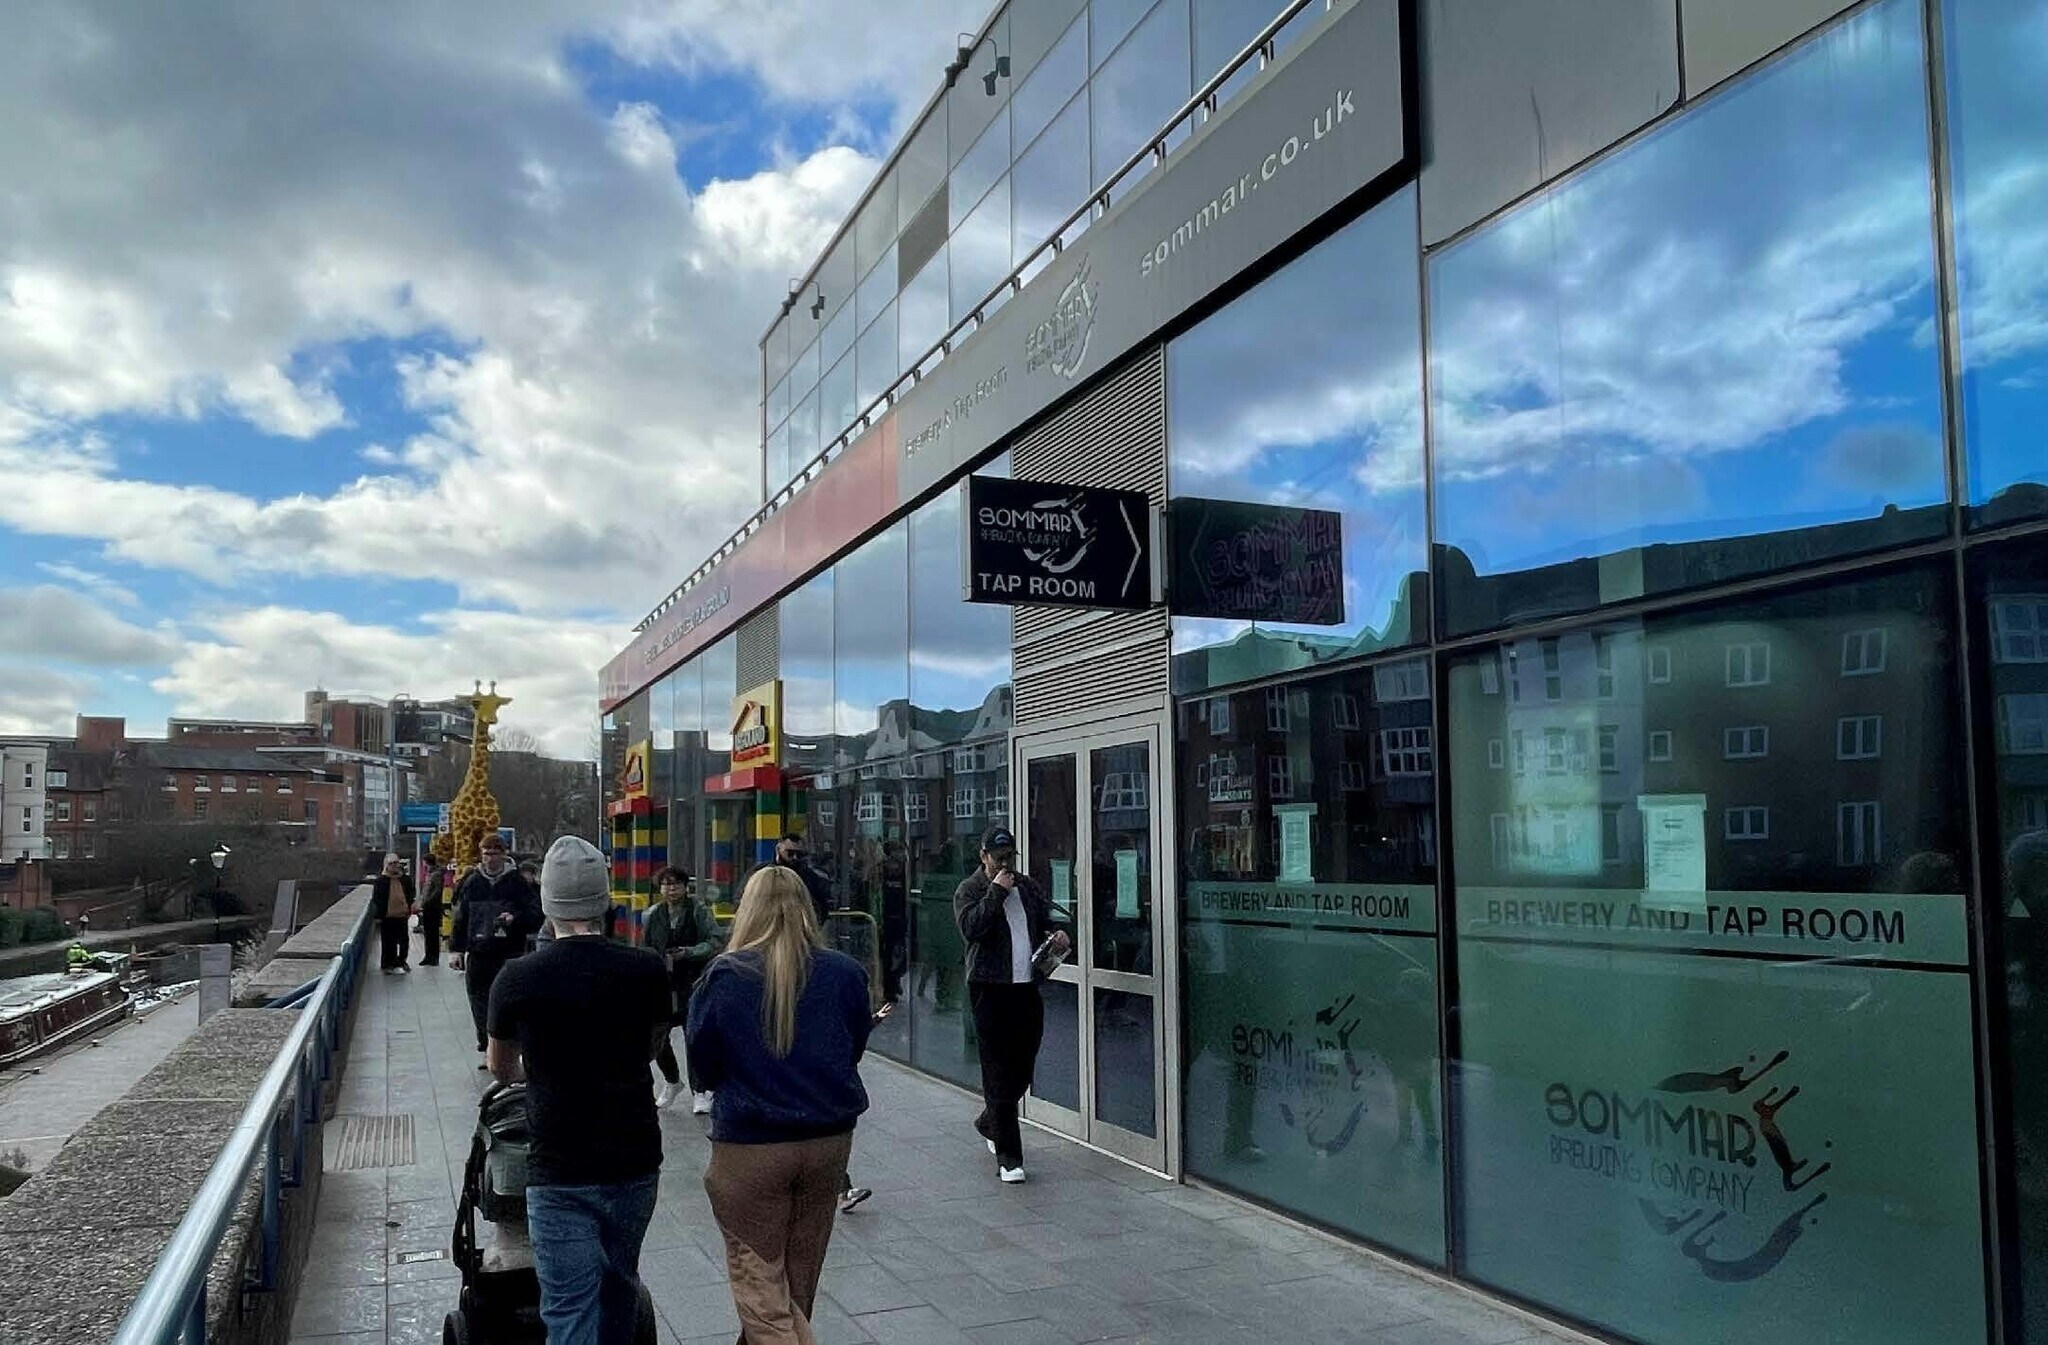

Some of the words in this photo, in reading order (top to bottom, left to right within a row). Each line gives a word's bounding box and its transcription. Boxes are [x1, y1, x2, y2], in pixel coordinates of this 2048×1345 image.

[1141, 90, 1355, 277] sommar.co.uk
[978, 507, 1071, 532] SOMMAR
[978, 573, 1022, 592] TAP
[1029, 577, 1096, 599] ROOM
[1202, 890, 1270, 911] BREWERY
[1311, 894, 1345, 914] TAP
[1351, 895, 1410, 919] ROOM
[1487, 899, 1615, 930] BREWERY
[1626, 902, 1690, 931] AND
[1705, 905, 1768, 936] TAP
[1783, 907, 1905, 945] ROOM
[1544, 1082, 1757, 1168] SOMMAR
